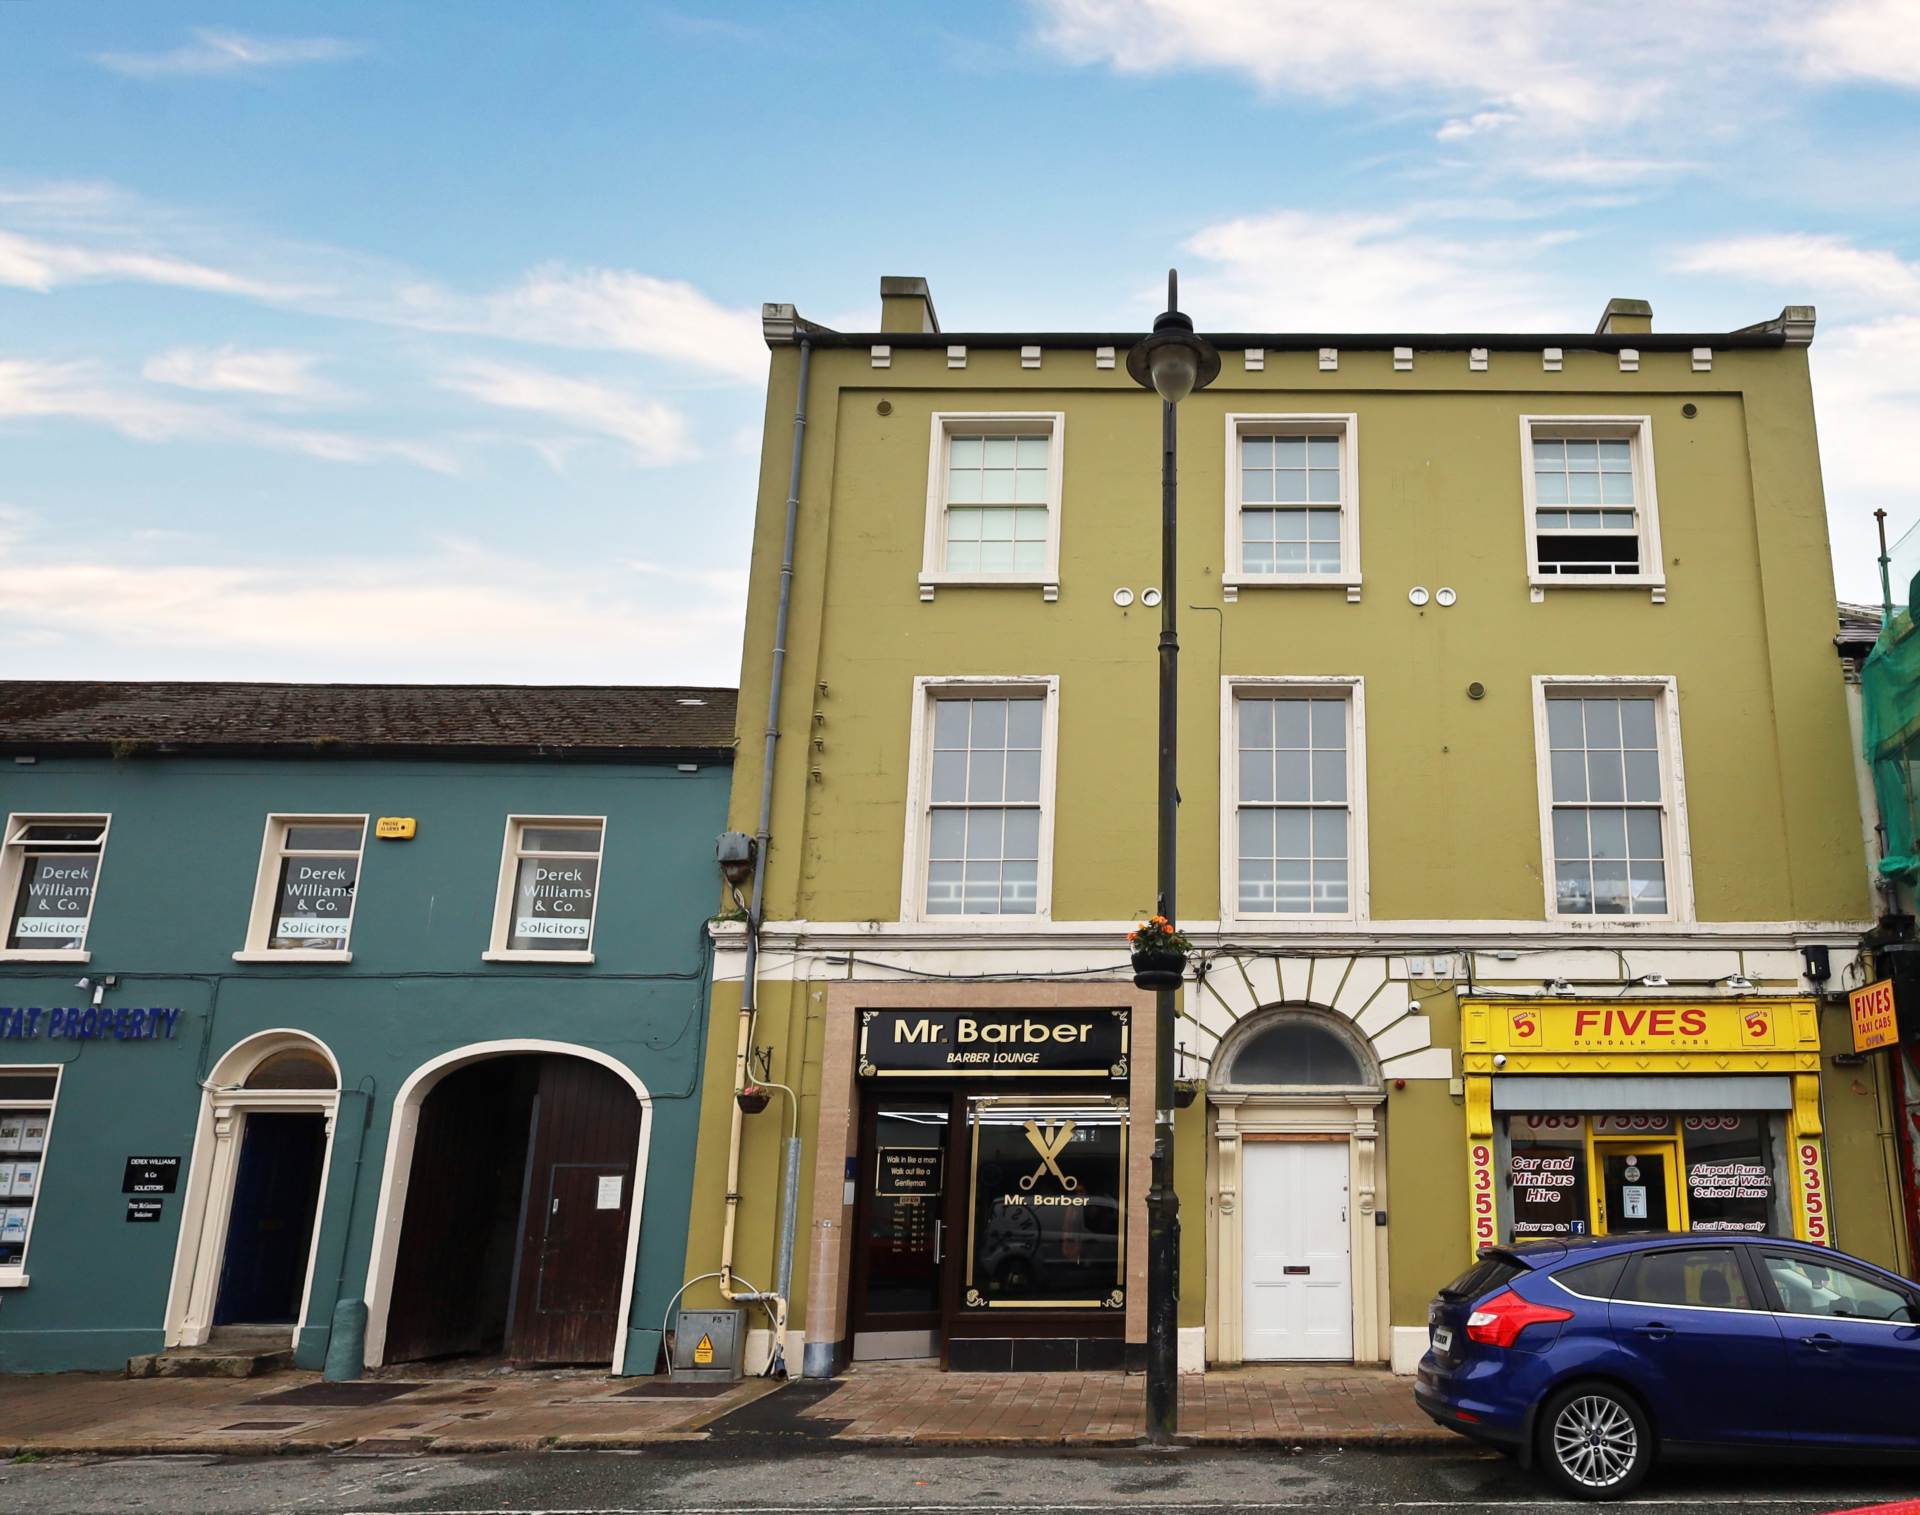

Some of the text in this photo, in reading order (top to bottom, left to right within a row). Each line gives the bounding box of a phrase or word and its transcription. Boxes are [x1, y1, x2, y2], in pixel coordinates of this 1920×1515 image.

[42, 866, 89, 879] Derek
[300, 867, 346, 880] Derek
[536, 868, 582, 881] Derek
[287, 883, 355, 897] Williams
[523, 885, 592, 898] Williams
[39, 899, 80, 910] & Co.
[297, 899, 338, 911] & Co.
[535, 900, 576, 912] & Co.
[20, 921, 86, 933] Solicitors
[281, 922, 347, 934] Solicitors
[519, 922, 585, 935] Solicitors
[1855, 987, 1891, 1021] FIVES
[48, 1007, 181, 1040] PROPERTY
[1574, 1009, 1707, 1036] FIVES
[1858, 1015, 1891, 1035] TAXI CABS
[894, 1018, 1093, 1043] Mr. Barber
[946, 1052, 1040, 1064] BARBER LOUNGE
[886, 1155, 900, 1163] Walk
[900, 1155, 907, 1163] in
[907, 1155, 917, 1163] like
[1511, 1156, 1575, 1170] Car and
[890, 1167, 904, 1175] Walk
[915, 1167, 925, 1175] like
[1691, 1163, 1766, 1177] Airport Runs
[894, 1179, 927, 1187] Gentleman
[1511, 1172, 1575, 1186] Minibus
[1688, 1175, 1772, 1187] Contract Work
[1525, 1188, 1561, 1202] Hire
[1693, 1187, 1768, 1198] School Runs
[1800, 1145, 1826, 1247] 9355
[1004, 1194, 1090, 1206] Mr. Barber
[1513, 1221, 1540, 1232] ollow
[1692, 1221, 1766, 1232] Local Fares only
